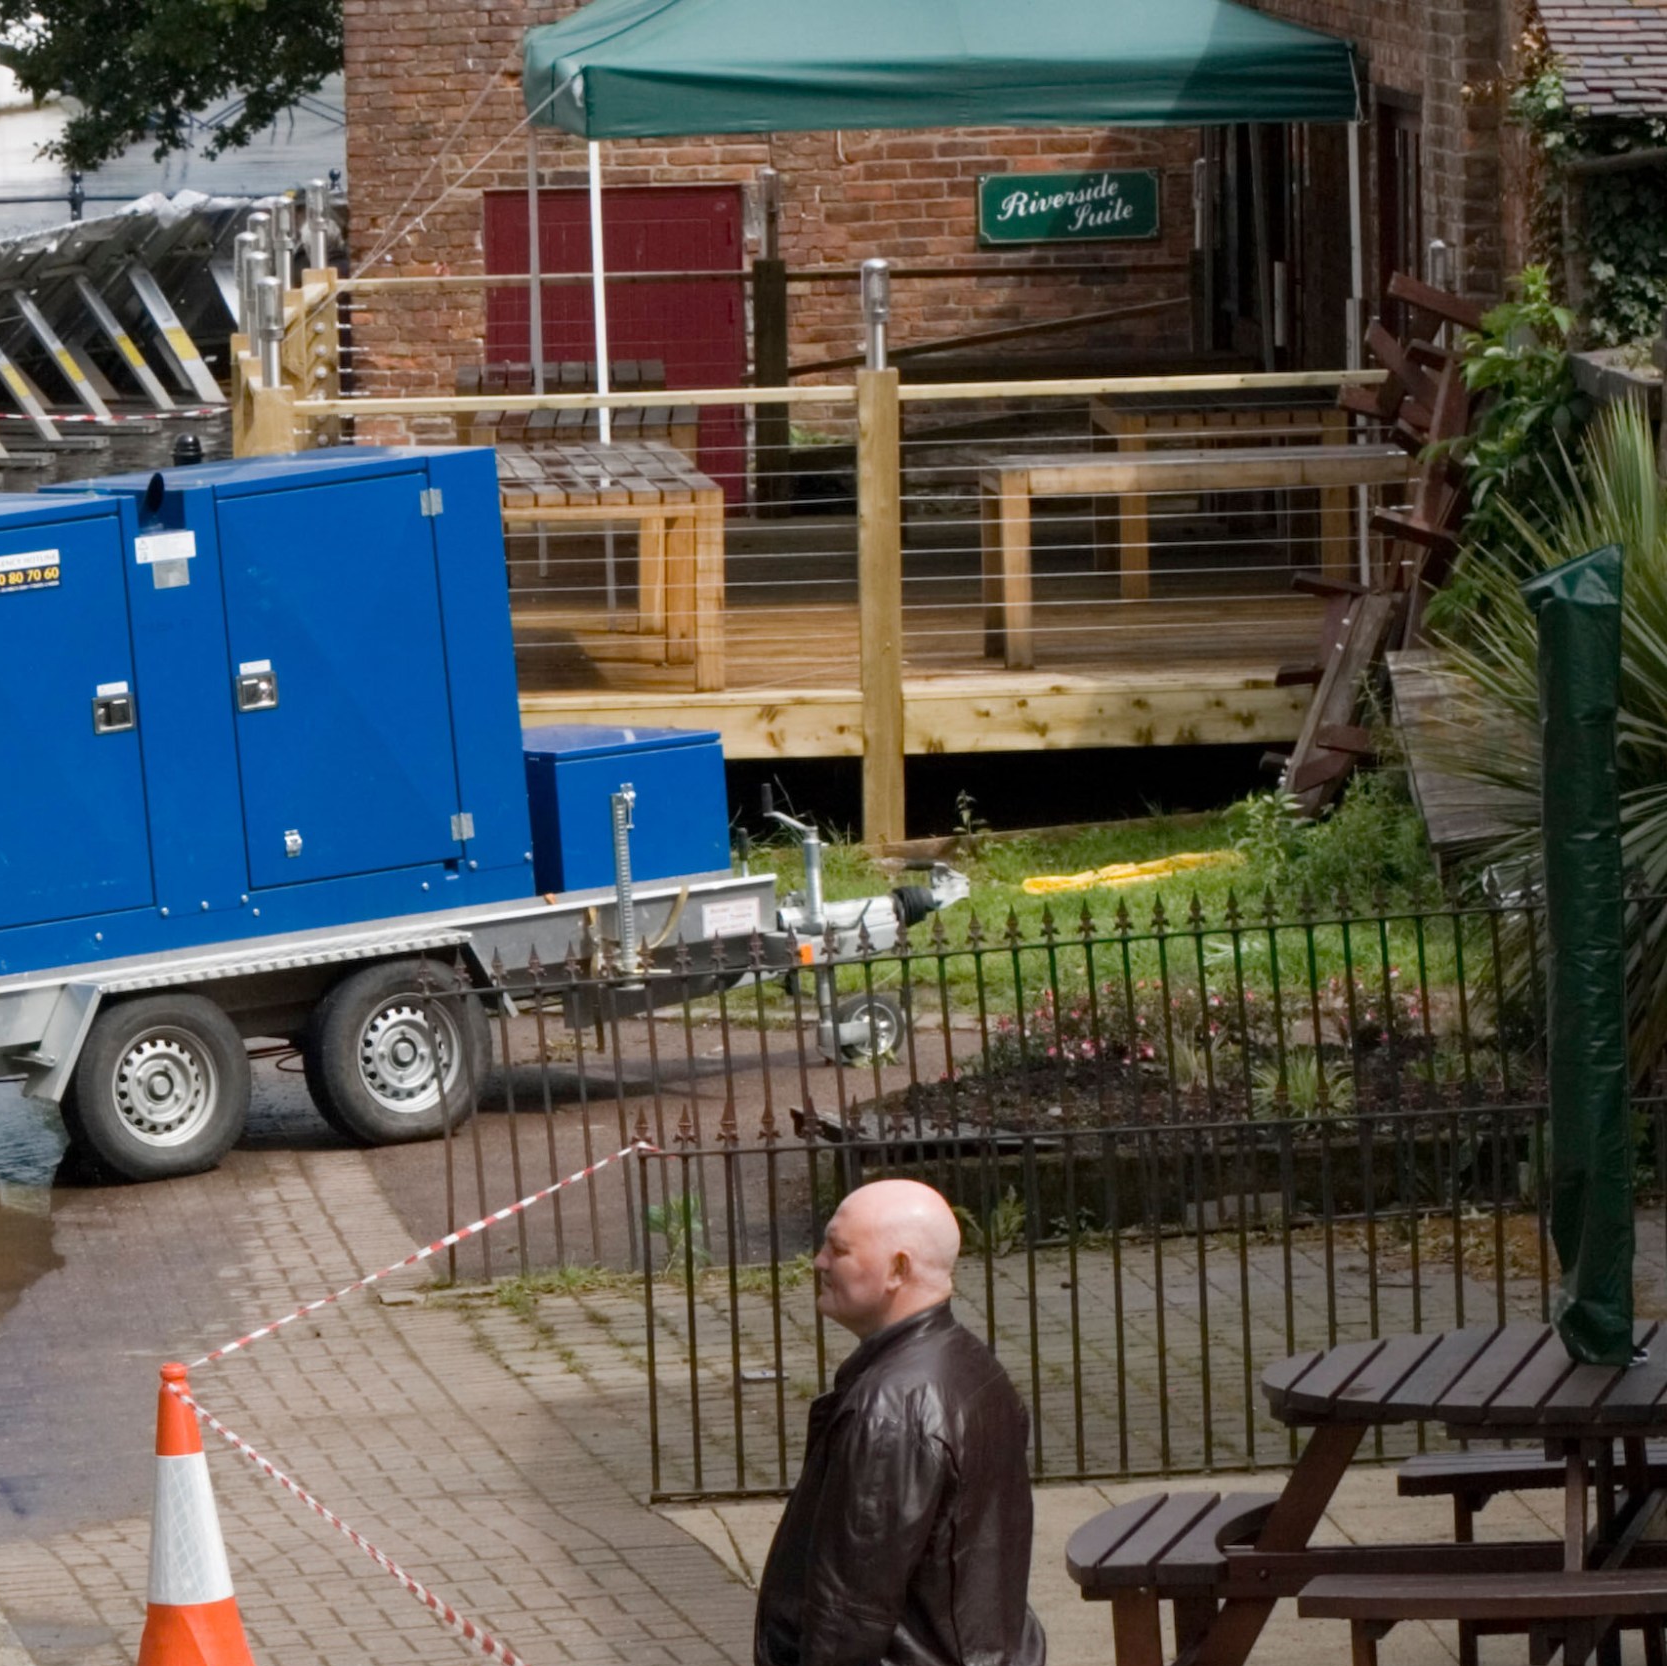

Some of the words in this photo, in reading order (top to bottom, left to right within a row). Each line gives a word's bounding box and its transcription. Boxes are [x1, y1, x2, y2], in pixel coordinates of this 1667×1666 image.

[997, 173, 1119, 221] Riverside
[1068, 198, 1133, 231] Suite
[23, 553, 57, 565] HOTLINE
[8, 571, 24, 584] 80
[27, 569, 42, 582] 70
[43, 567, 59, 580] 60
